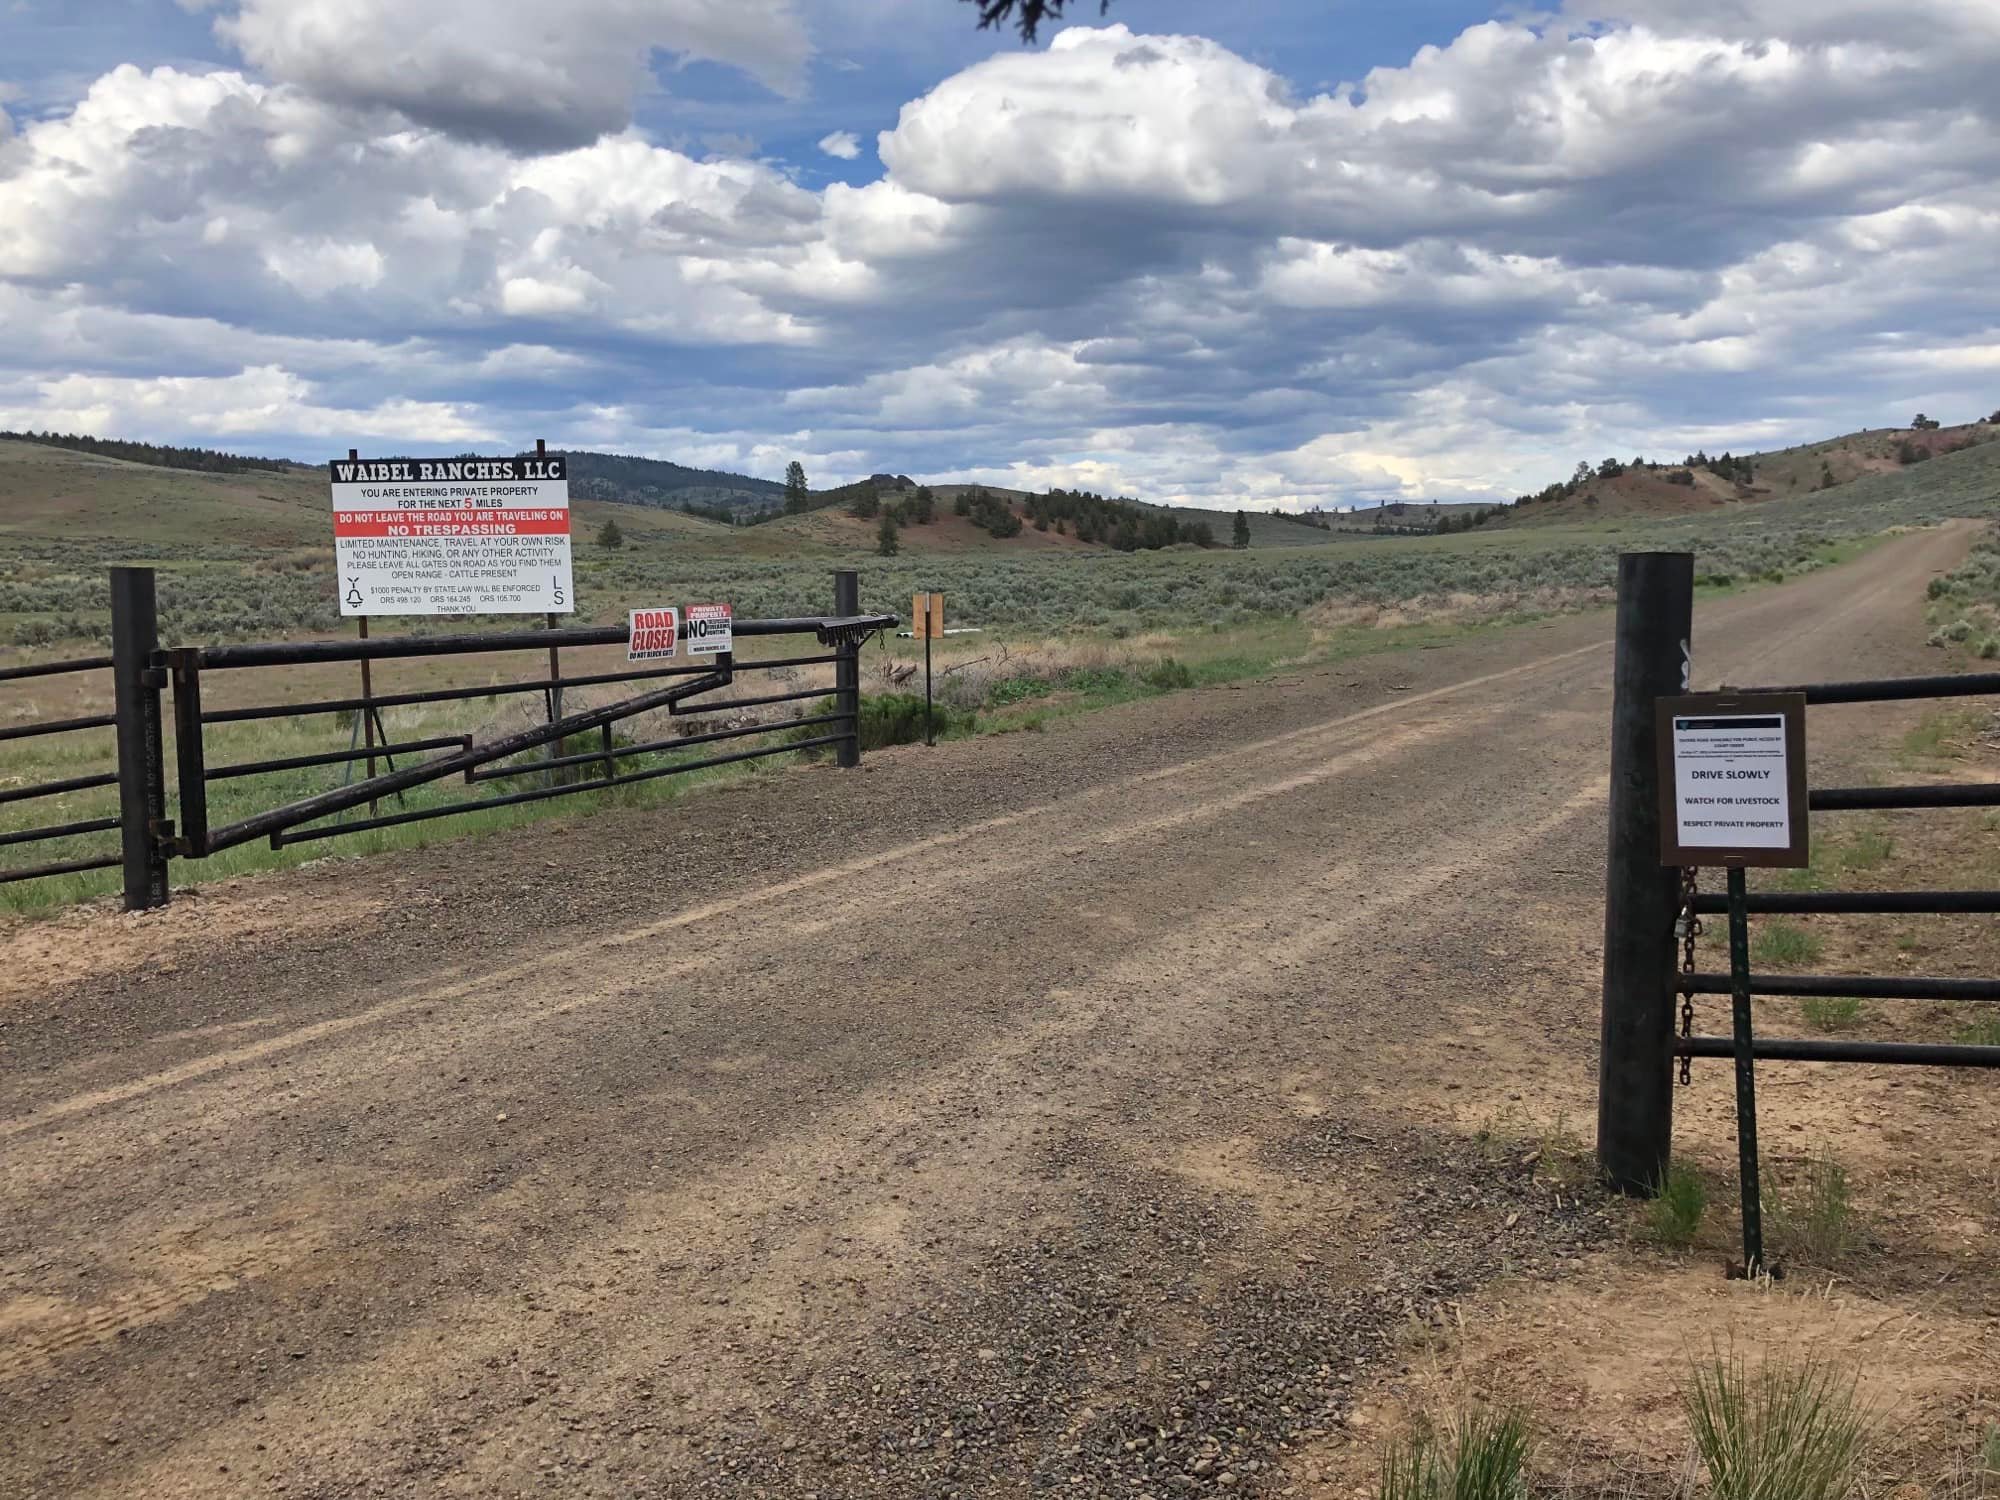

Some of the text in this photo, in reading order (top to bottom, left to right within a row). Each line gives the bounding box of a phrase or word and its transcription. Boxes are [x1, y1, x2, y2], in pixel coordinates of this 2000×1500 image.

[336, 462, 560, 481] WAIBEL RANCHES, LLC
[361, 487, 538, 497] YOU ARE ENTERING PRIVATE PROPERTY
[398, 498, 502, 509] FOR THE NEXT 5 MILES
[339, 511, 563, 523] DO NOT LEAVE THE ROAD YOU ARE TRAVELING ON
[388, 524, 516, 535] NO TRESPASSING
[340, 540, 375, 549] LIMITED
[445, 539, 478, 547] TRAVEL
[481, 538, 492, 546] AT
[494, 538, 520, 546] YOUR
[522, 537, 543, 546] OWN
[546, 537, 566, 545] RISK
[352, 551, 366, 559] NO
[446, 549, 460, 558] OR
[462, 549, 480, 557] ANY
[482, 548, 512, 557] OTHER
[516, 548, 554, 557] ACTIVITY
[406, 560, 420, 568] ALL
[422, 560, 447, 568] GATES
[519, 559, 538, 567] FIND
[540, 559, 561, 567] THEM
[392, 571, 414, 579] OPEN
[449, 570, 479, 578] CATTLE
[481, 570, 517, 578] PRESENT
[553, 575, 562, 589] L
[391, 586, 422, 594] PENALTY
[435, 585, 456, 593] STATE
[457, 585, 472, 593] LAW
[502, 584, 540, 592] ENFORCED
[554, 591, 564, 605] S
[635, 612, 673, 629] ROAD
[689, 620, 706, 638] NO
[632, 629, 674, 651] CLOSED
[1691, 770, 1770, 779] DRIVE SLOWLY
